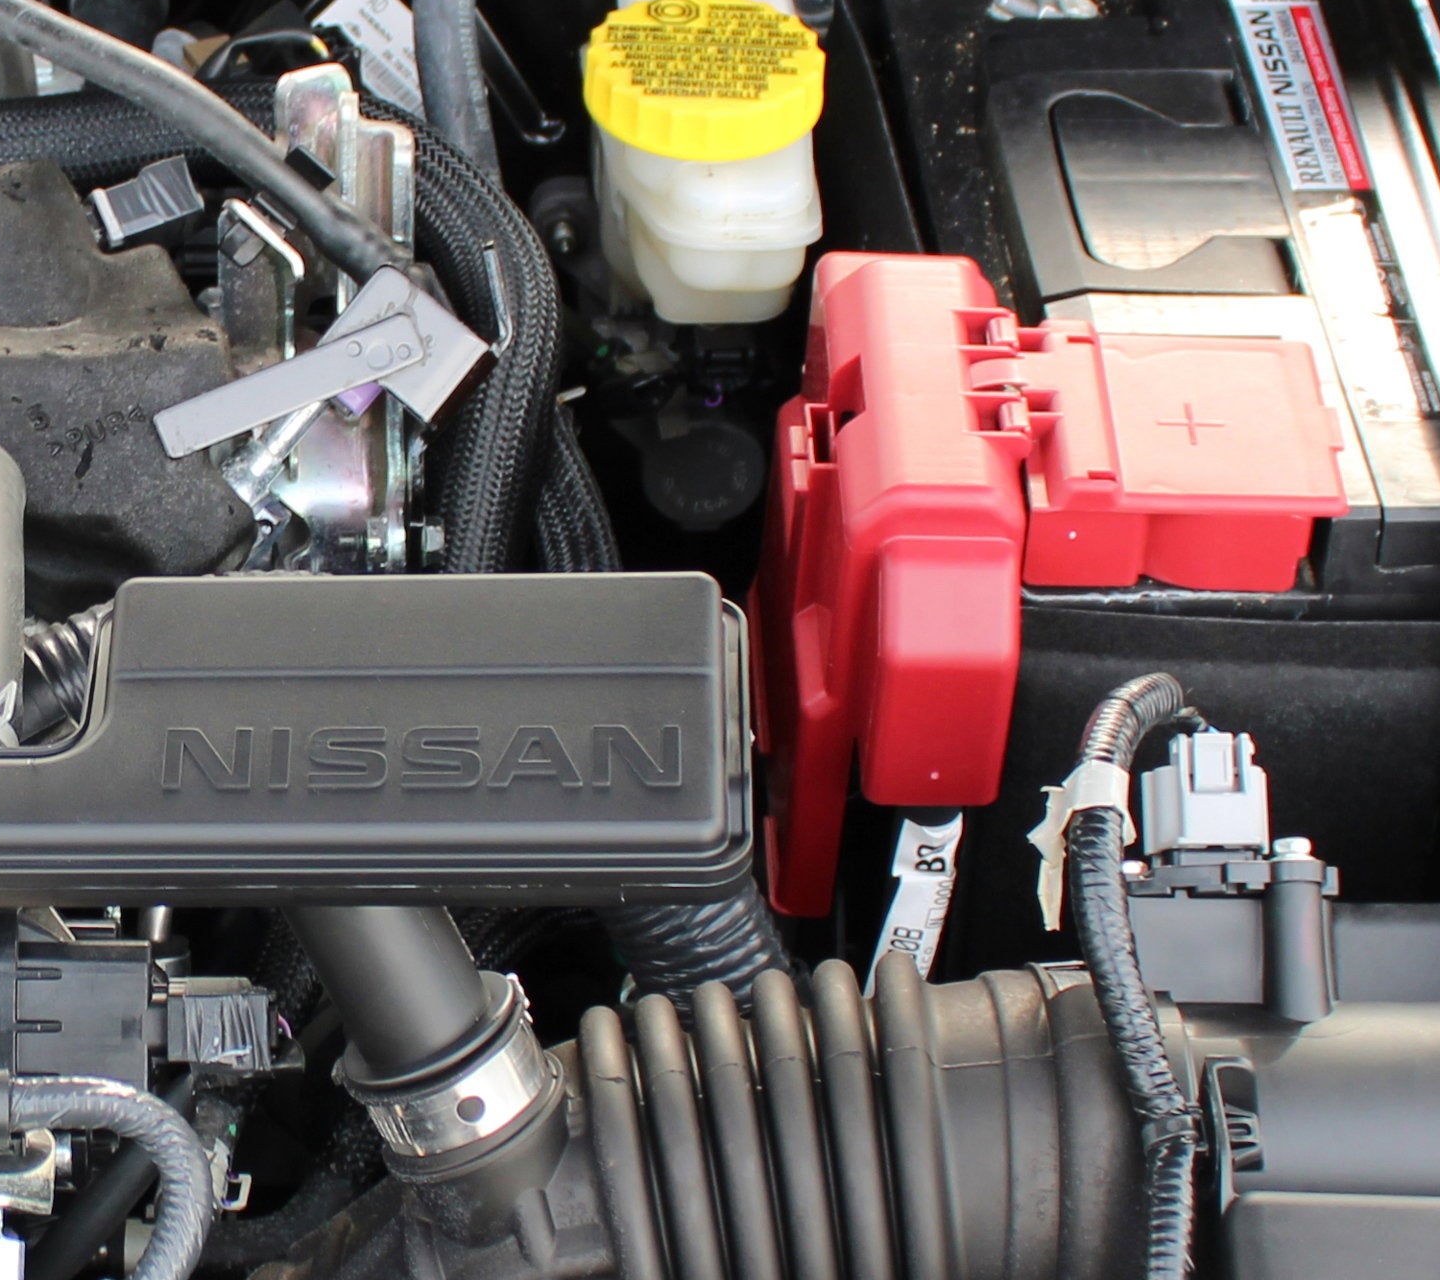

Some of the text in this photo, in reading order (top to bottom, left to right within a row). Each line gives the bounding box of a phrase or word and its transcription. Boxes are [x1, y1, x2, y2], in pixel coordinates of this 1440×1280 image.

[1246, 10, 1297, 98] NISSAN
[1277, 103, 1327, 184] RENAULT
[161, 723, 684, 794] NISSAN
